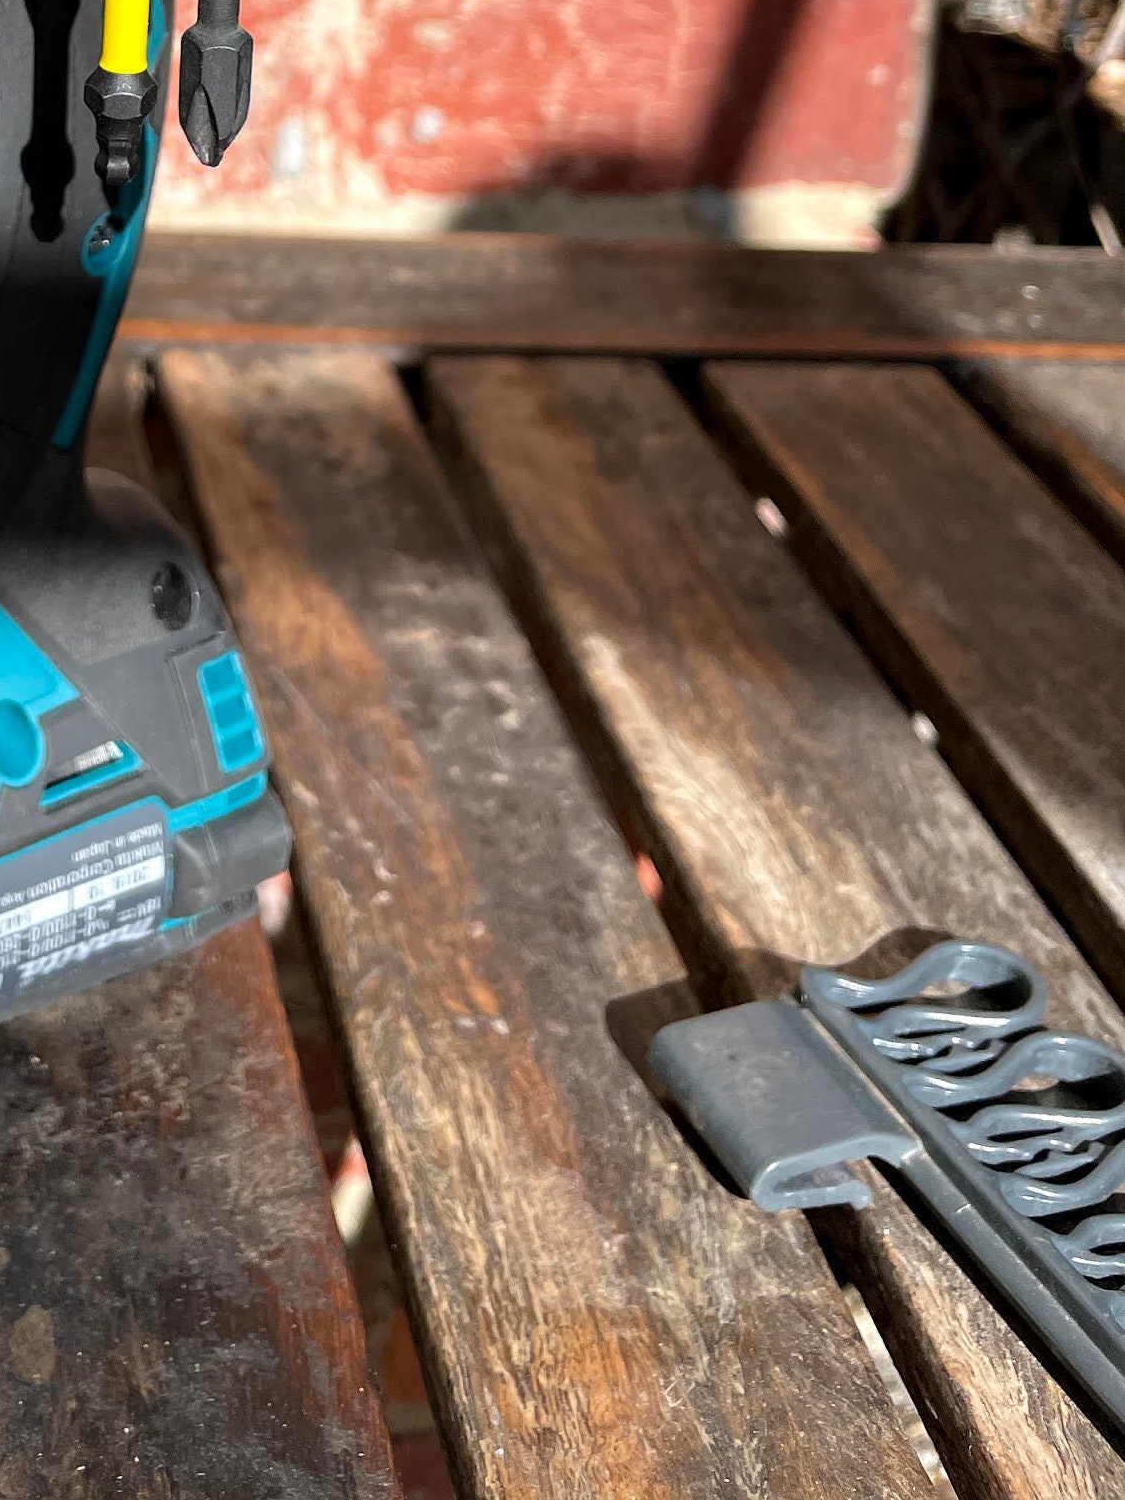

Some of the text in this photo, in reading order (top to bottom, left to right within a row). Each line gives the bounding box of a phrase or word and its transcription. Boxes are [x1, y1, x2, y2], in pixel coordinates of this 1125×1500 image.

[71, 822, 163, 863] Made in Japan
[114, 840, 164, 866] Makita
[27, 858, 114, 900] Corporation
